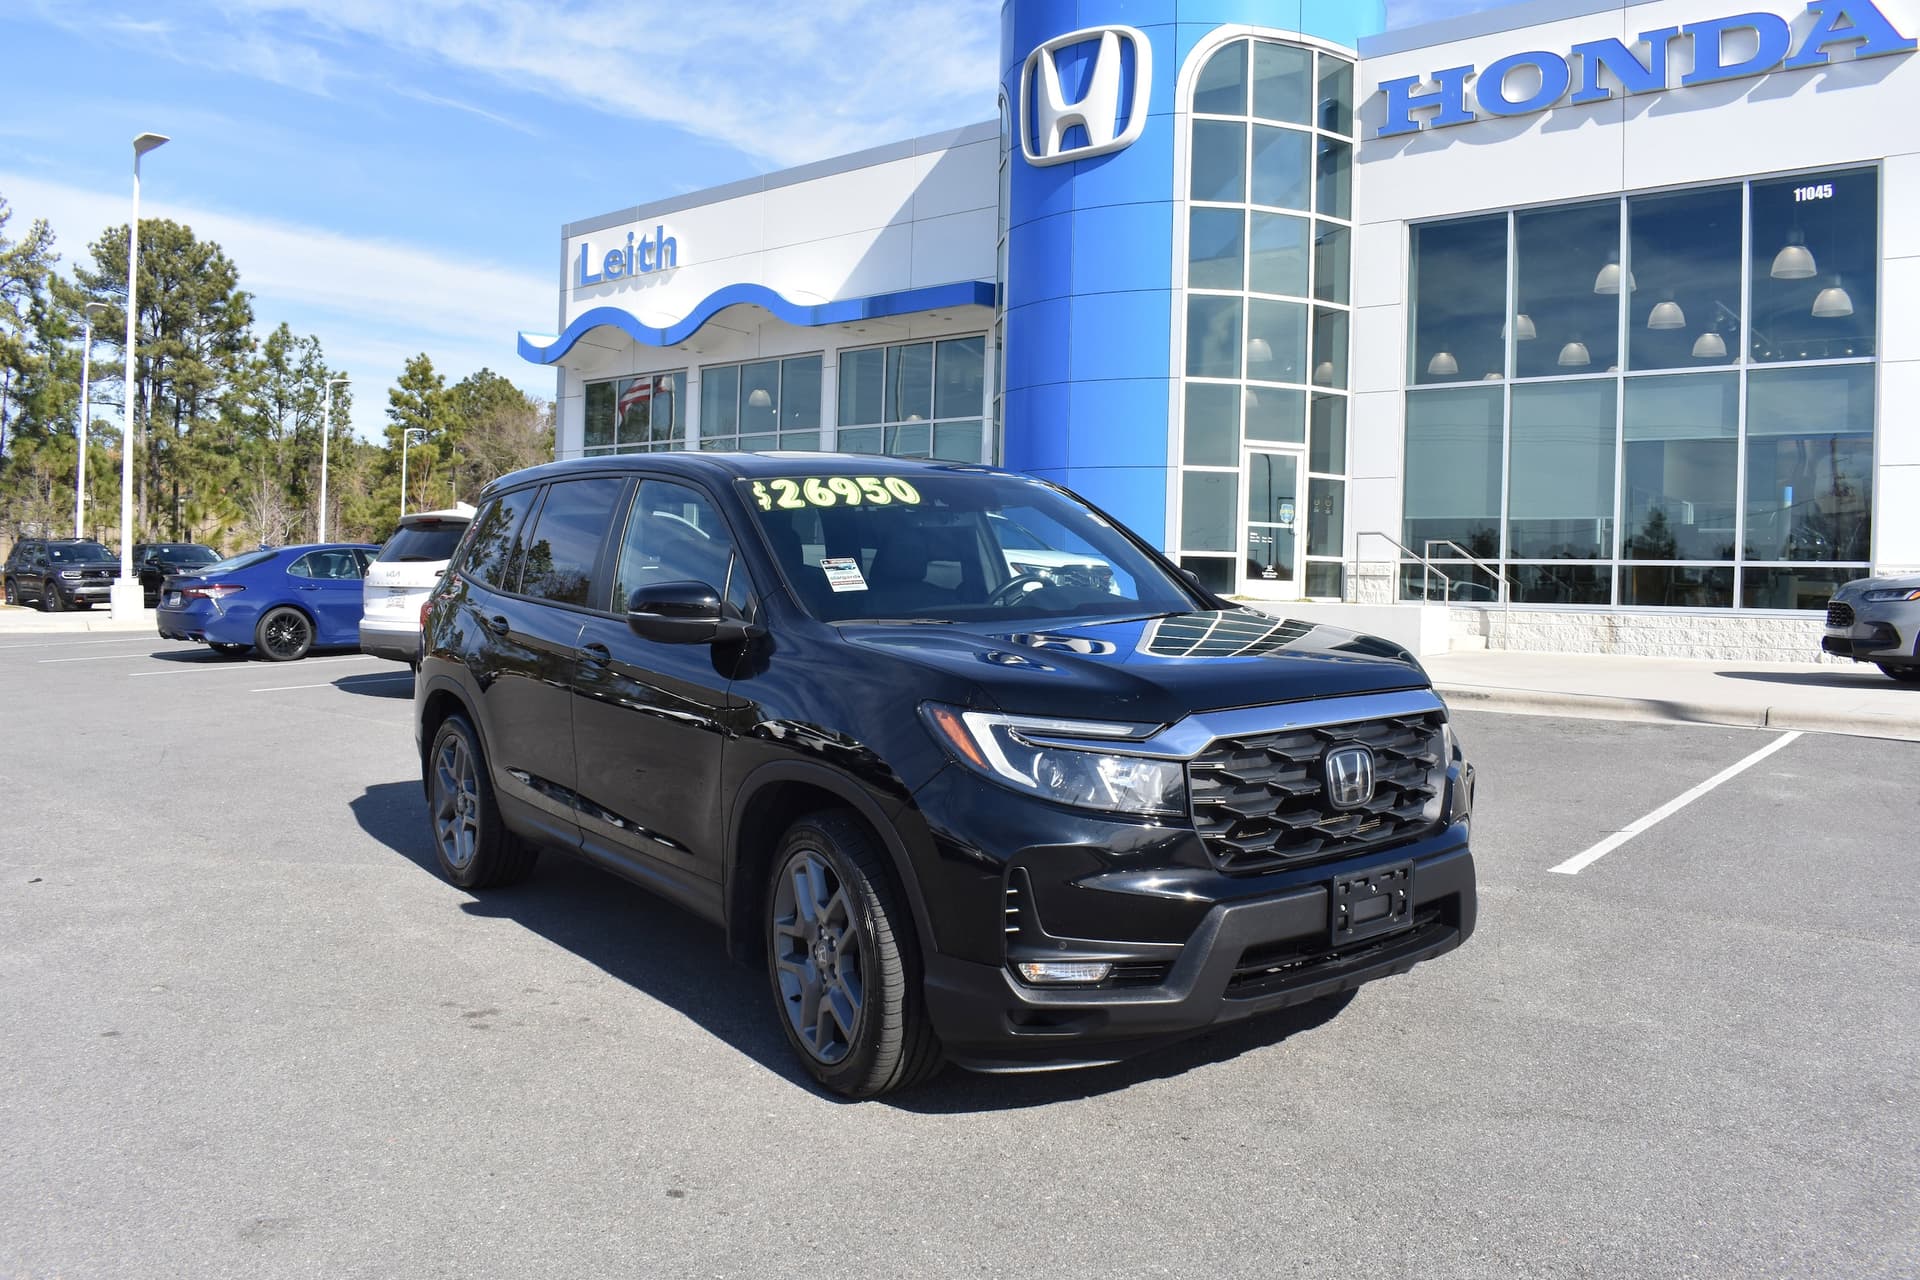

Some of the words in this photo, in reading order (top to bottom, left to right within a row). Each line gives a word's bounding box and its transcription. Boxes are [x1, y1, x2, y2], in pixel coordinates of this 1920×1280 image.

[1377, 0, 1919, 137] HONDA
[1793, 184, 1833, 202] 11045
[581, 225, 677, 286] Leith
[752, 476, 922, 511] $26950
